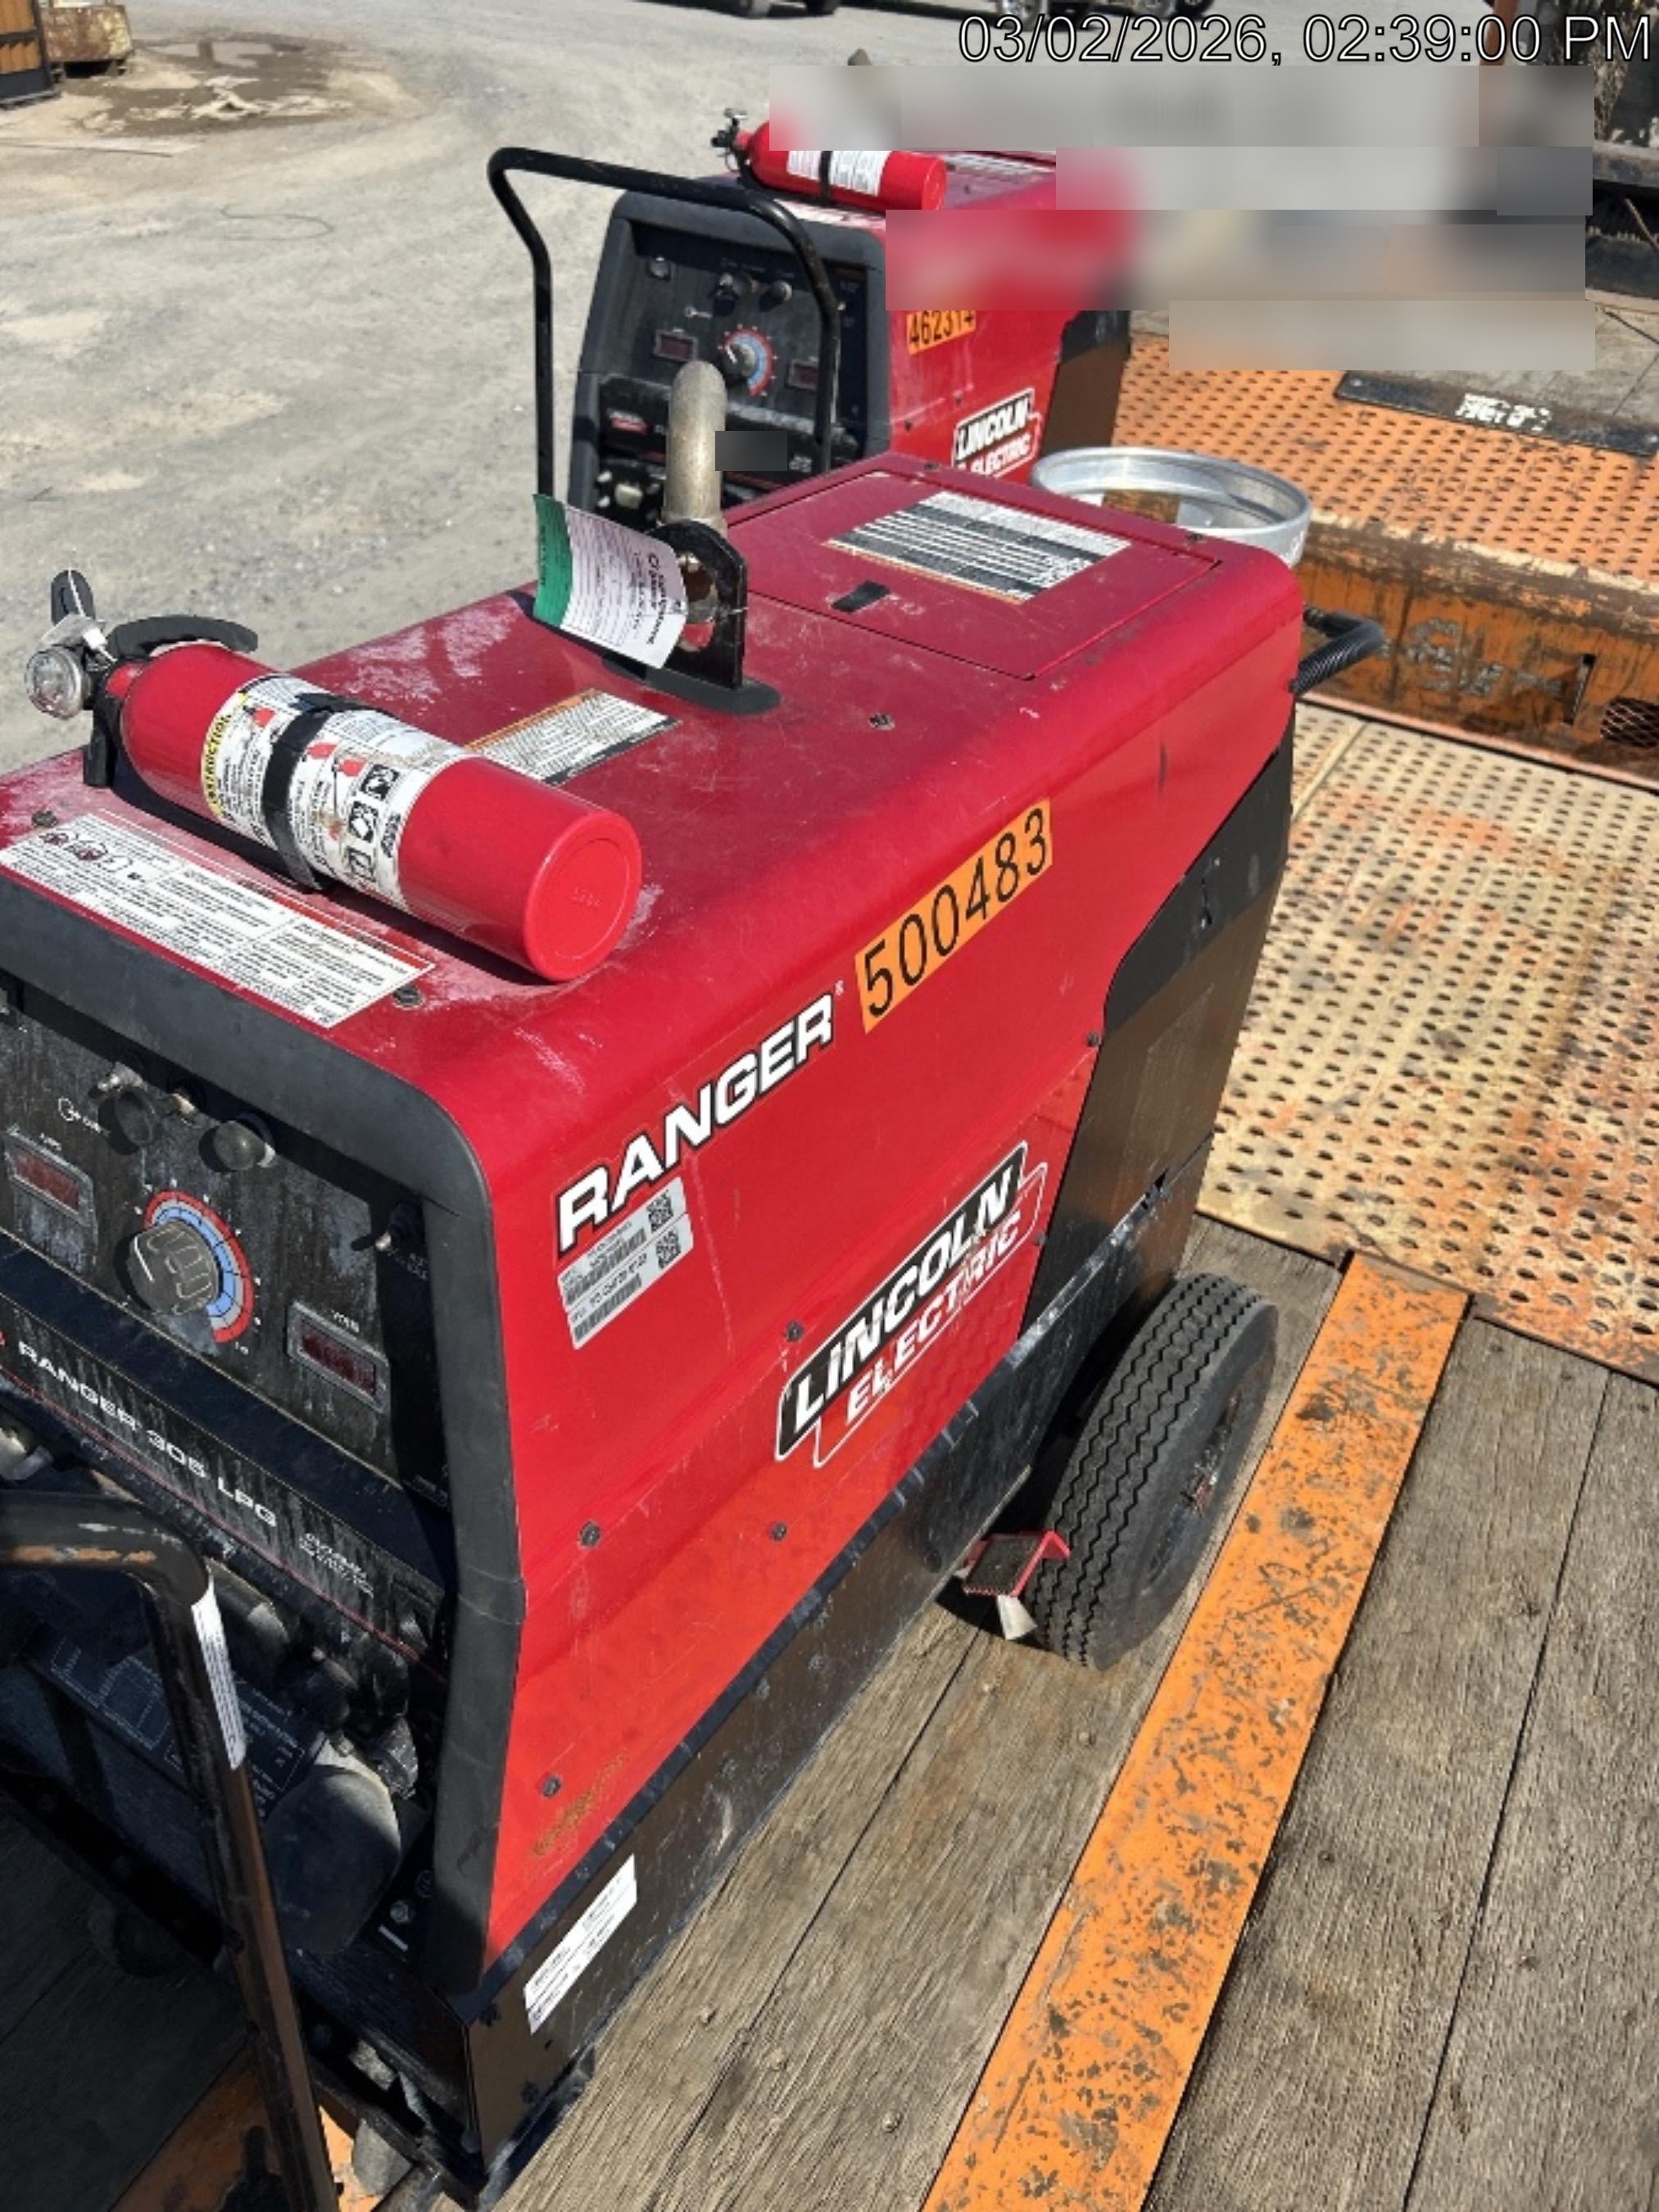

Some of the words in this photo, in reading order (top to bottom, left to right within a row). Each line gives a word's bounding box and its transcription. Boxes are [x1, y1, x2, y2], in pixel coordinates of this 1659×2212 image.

[956, 397, 1029, 461] LINCOLN
[864, 808, 1046, 1018] 500483
[558, 991, 833, 1257] RANGER
[794, 1164, 1013, 1434] LINCOLN
[845, 1208, 1022, 1426] ELECTRIC
[18, 1340, 138, 1432] RANGER
[216, 1475, 277, 1527] LPG
